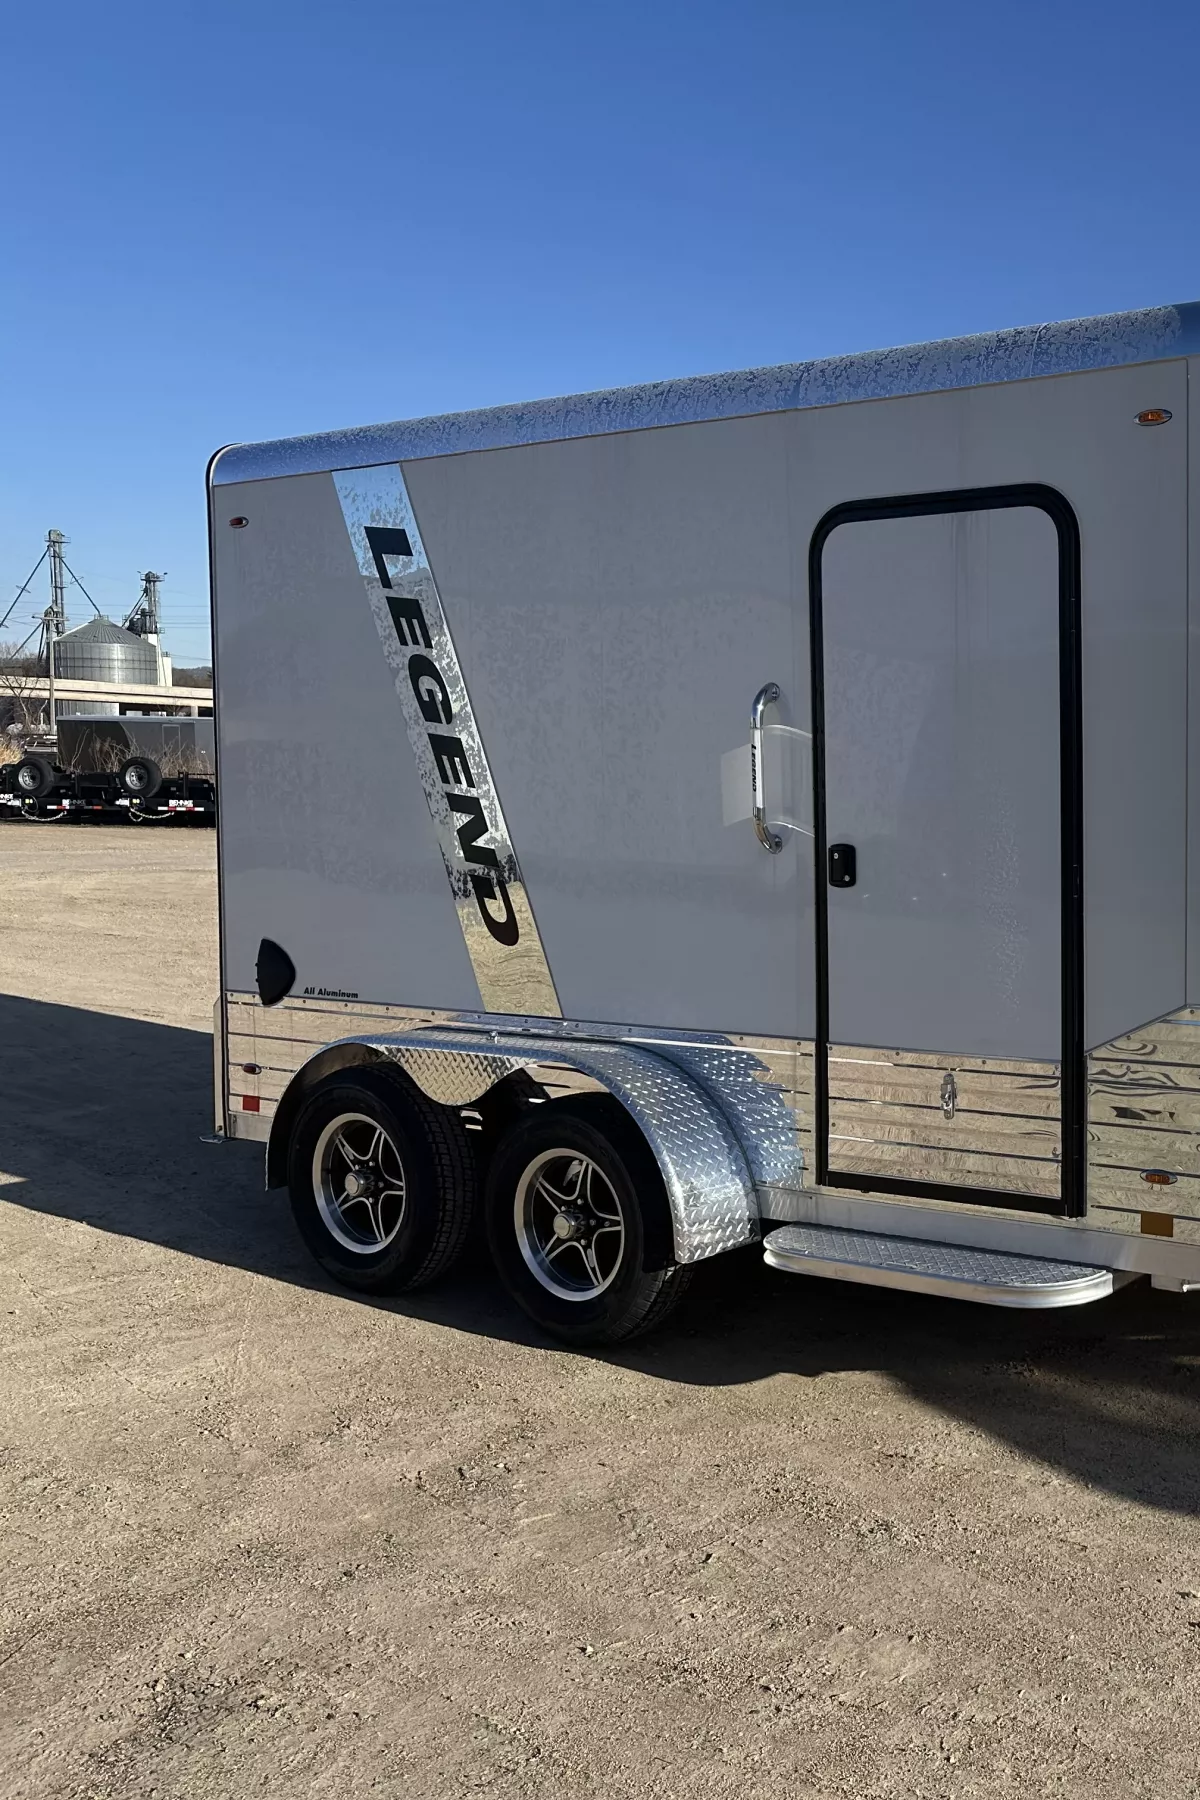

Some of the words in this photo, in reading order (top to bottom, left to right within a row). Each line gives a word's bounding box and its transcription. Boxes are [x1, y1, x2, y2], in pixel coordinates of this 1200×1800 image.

[364, 526, 519, 946] LEGEND
[304, 986, 315, 995] All
[318, 988, 358, 998] Aluminum
